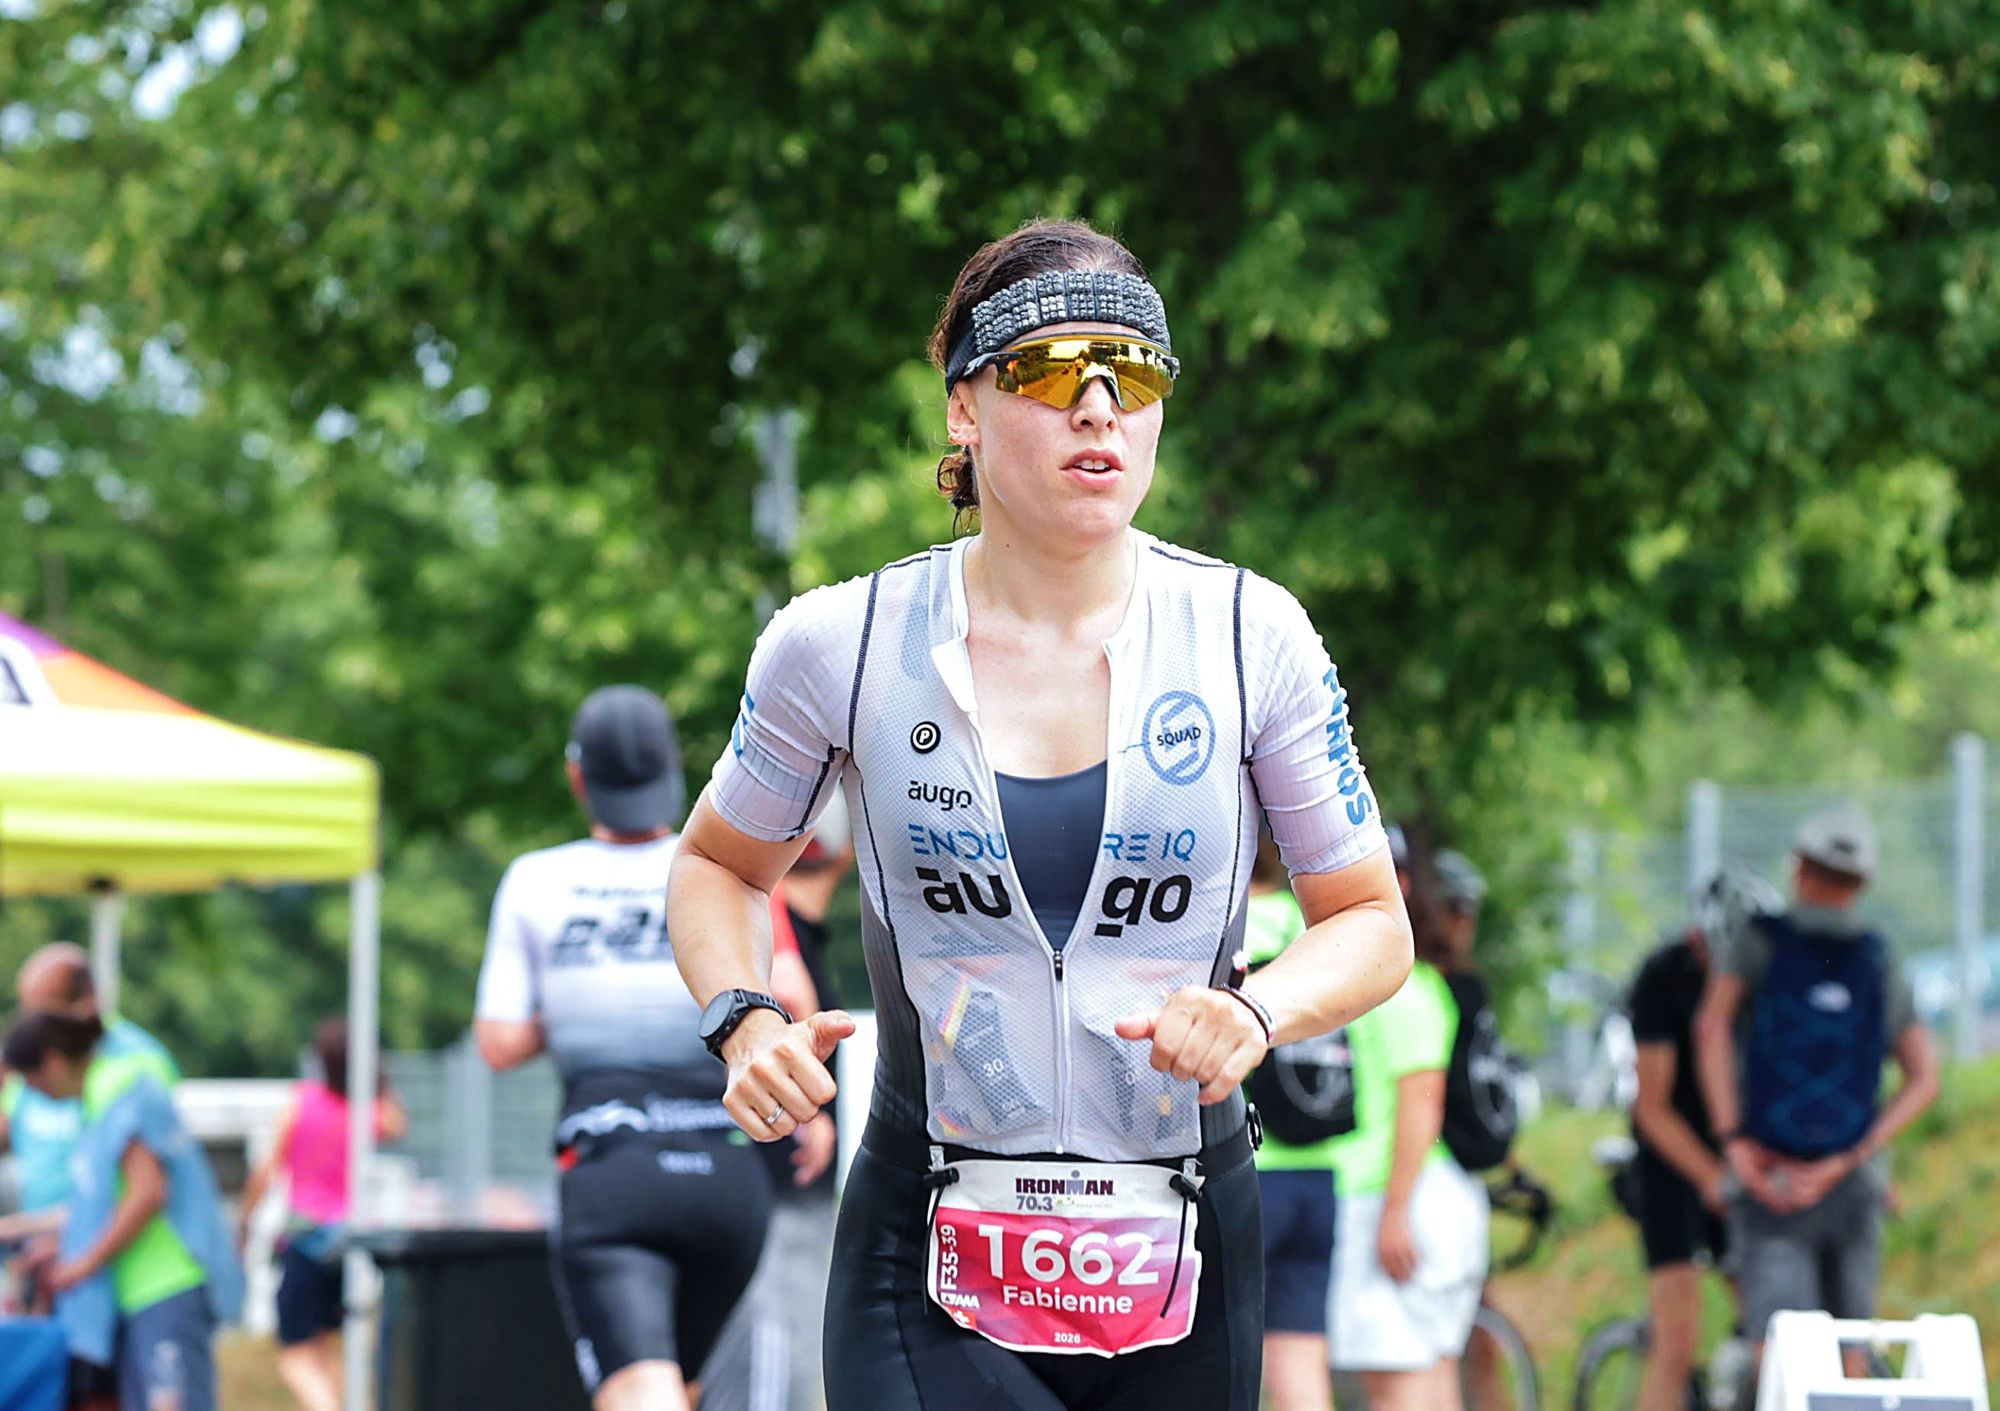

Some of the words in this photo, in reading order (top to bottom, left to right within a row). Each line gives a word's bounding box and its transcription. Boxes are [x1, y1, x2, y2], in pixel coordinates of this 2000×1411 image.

[1157, 727, 1202, 747] SQUAD
[908, 823, 1007, 860] ENDU
[1103, 834, 1151, 862] RE
[1161, 829, 1196, 862] IQ
[1016, 1170, 1113, 1195] IRONMAN
[1016, 1195, 1053, 1211] 70.3
[940, 1224, 959, 1290] F35-39
[978, 1224, 1159, 1287] 1662
[1002, 1285, 1133, 1314] Fabienne
[1054, 1332, 1081, 1344] 2026
